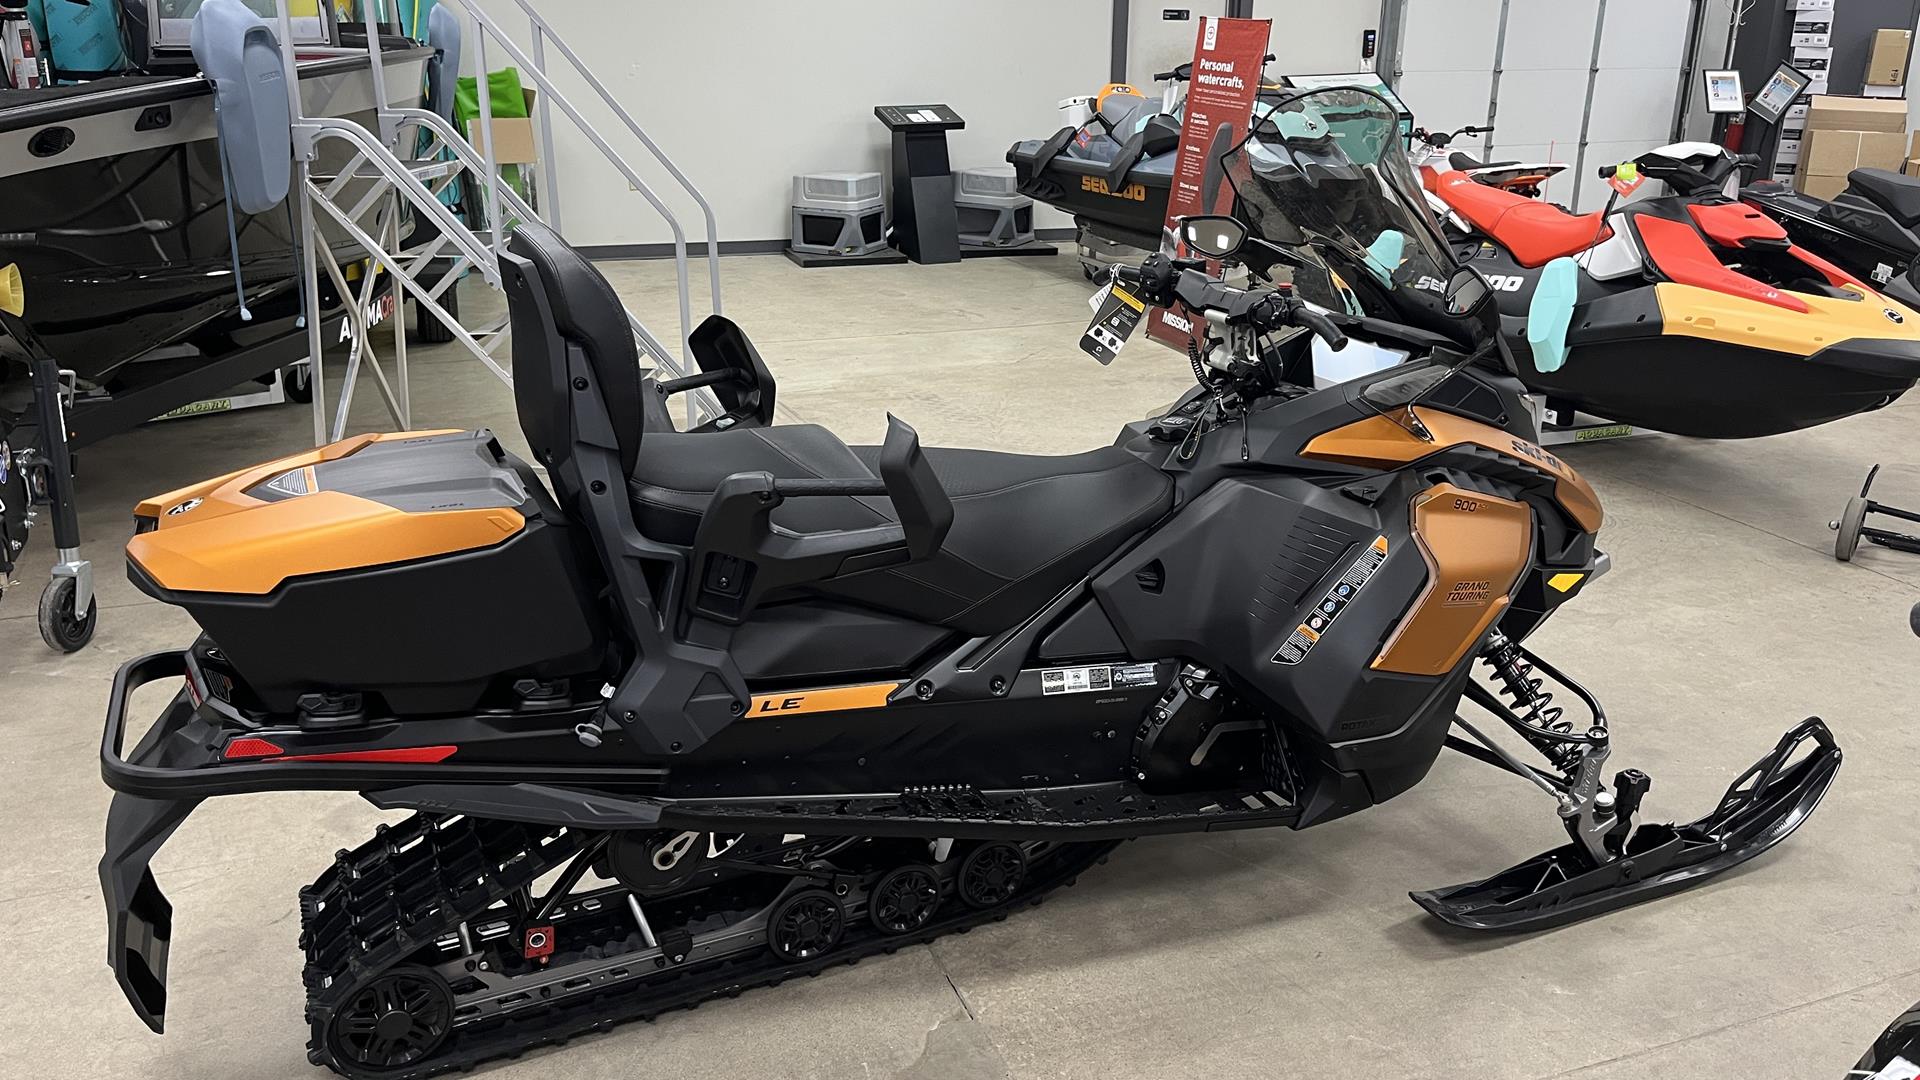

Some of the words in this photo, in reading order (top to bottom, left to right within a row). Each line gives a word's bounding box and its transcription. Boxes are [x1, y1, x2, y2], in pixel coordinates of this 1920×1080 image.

[1199, 58, 1235, 73] Personal
[1197, 73, 1245, 91] watercrafts,
[1453, 498, 1478, 512] 900
[1453, 581, 1490, 592] GRAND
[1446, 591, 1490, 601] TOURING
[759, 697, 805, 713] LE
